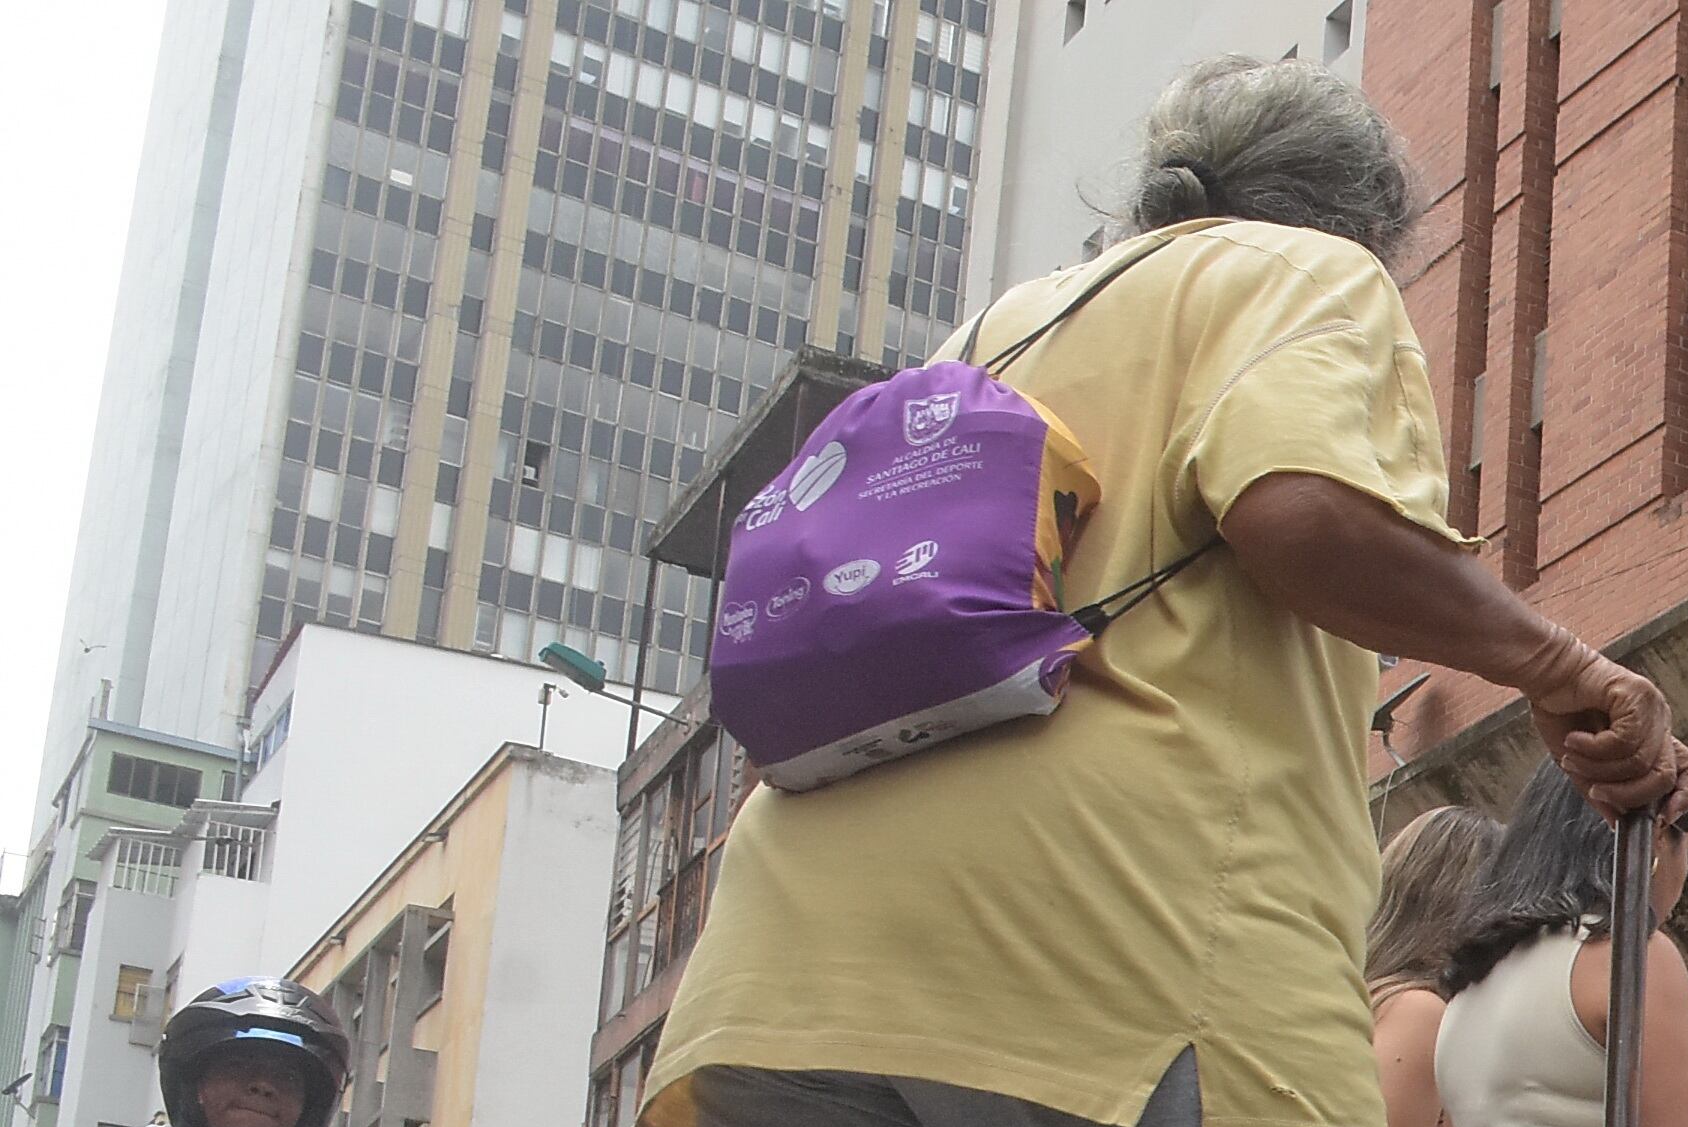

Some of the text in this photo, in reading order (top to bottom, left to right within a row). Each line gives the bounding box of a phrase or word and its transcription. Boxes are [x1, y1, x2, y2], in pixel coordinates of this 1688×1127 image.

[943, 436, 957, 447] DE
[866, 442, 981, 485] SANTIAGO DE CALI
[936, 460, 984, 476] DEPORTE
[885, 490, 897, 500] LA
[746, 501, 787, 531] Cali
[834, 565, 866, 583] Yupi
